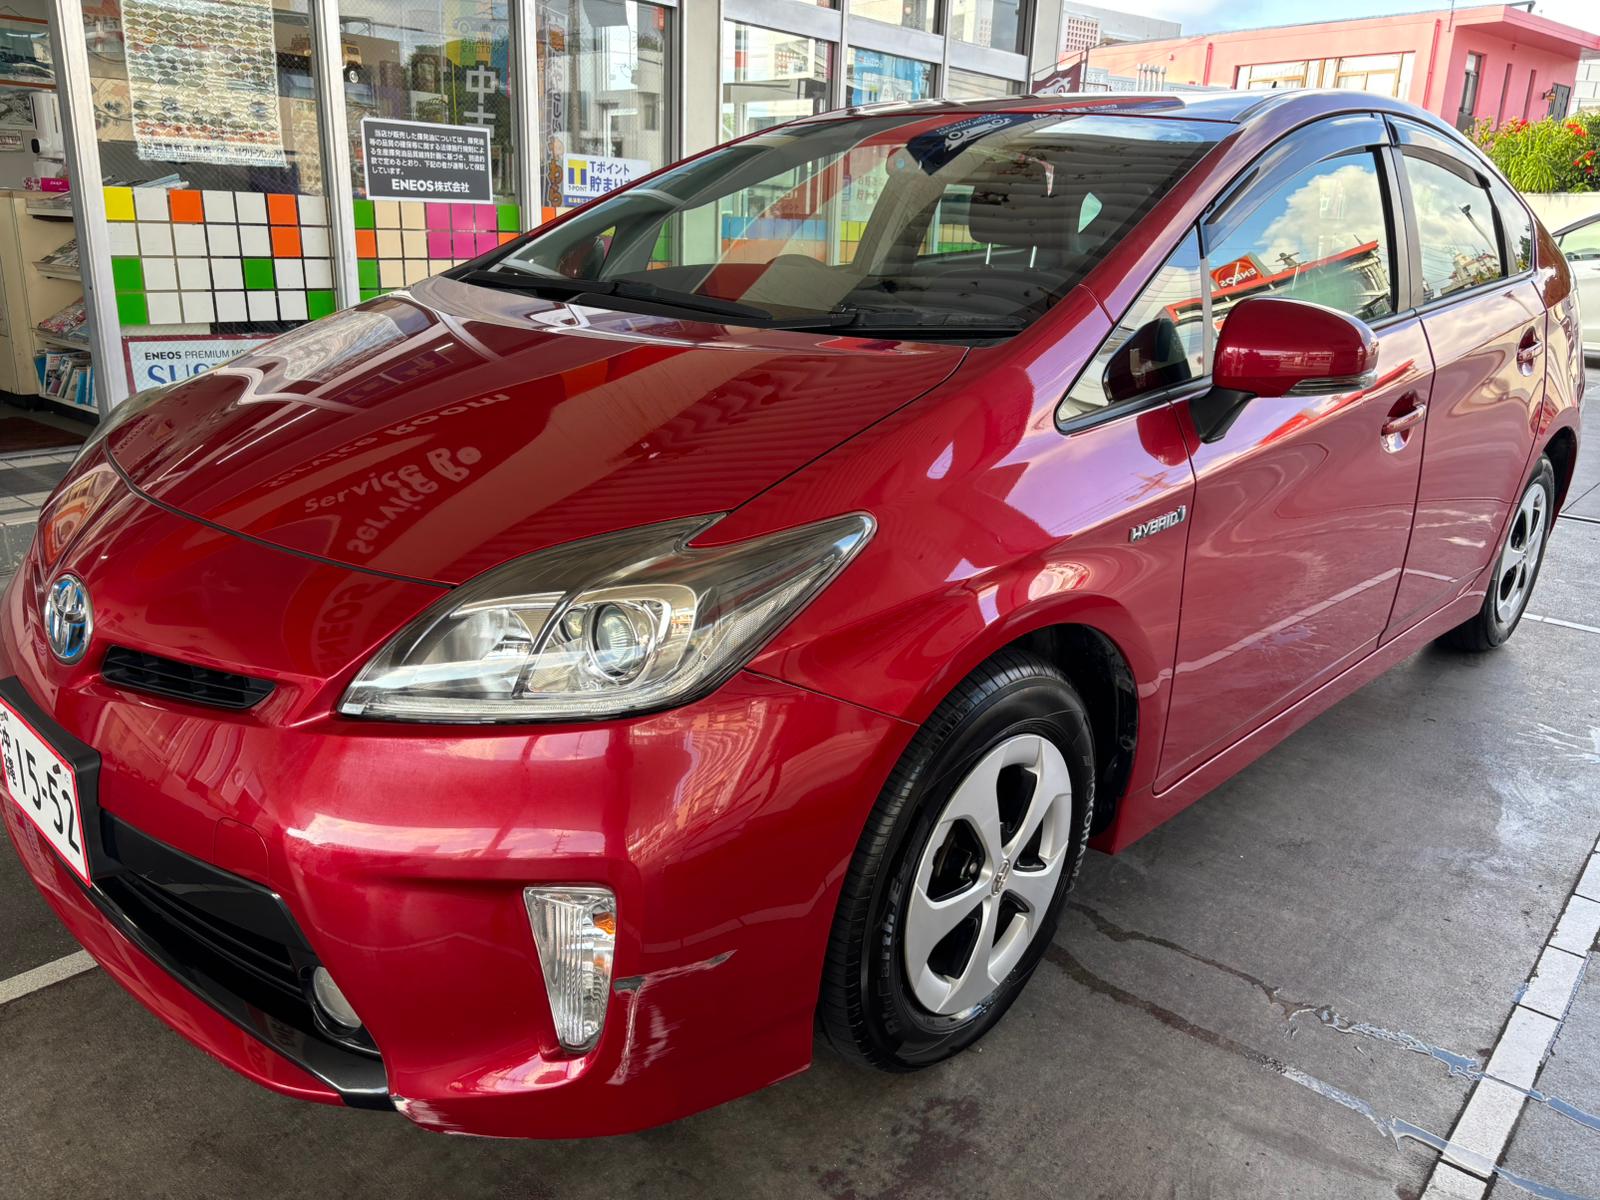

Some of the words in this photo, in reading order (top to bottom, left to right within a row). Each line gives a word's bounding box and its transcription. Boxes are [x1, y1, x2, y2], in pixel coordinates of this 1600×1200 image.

[372, 166, 404, 175] しています。
[590, 161, 630, 175] Tポイント
[391, 178, 470, 193] ENEOS株式会社
[590, 176, 631, 192] 貯まり
[144, 351, 182, 361] ENEOS
[185, 350, 230, 359] PREMIUM
[1130, 509, 1181, 542] HYBRID
[15, 737, 81, 856] 15-52
